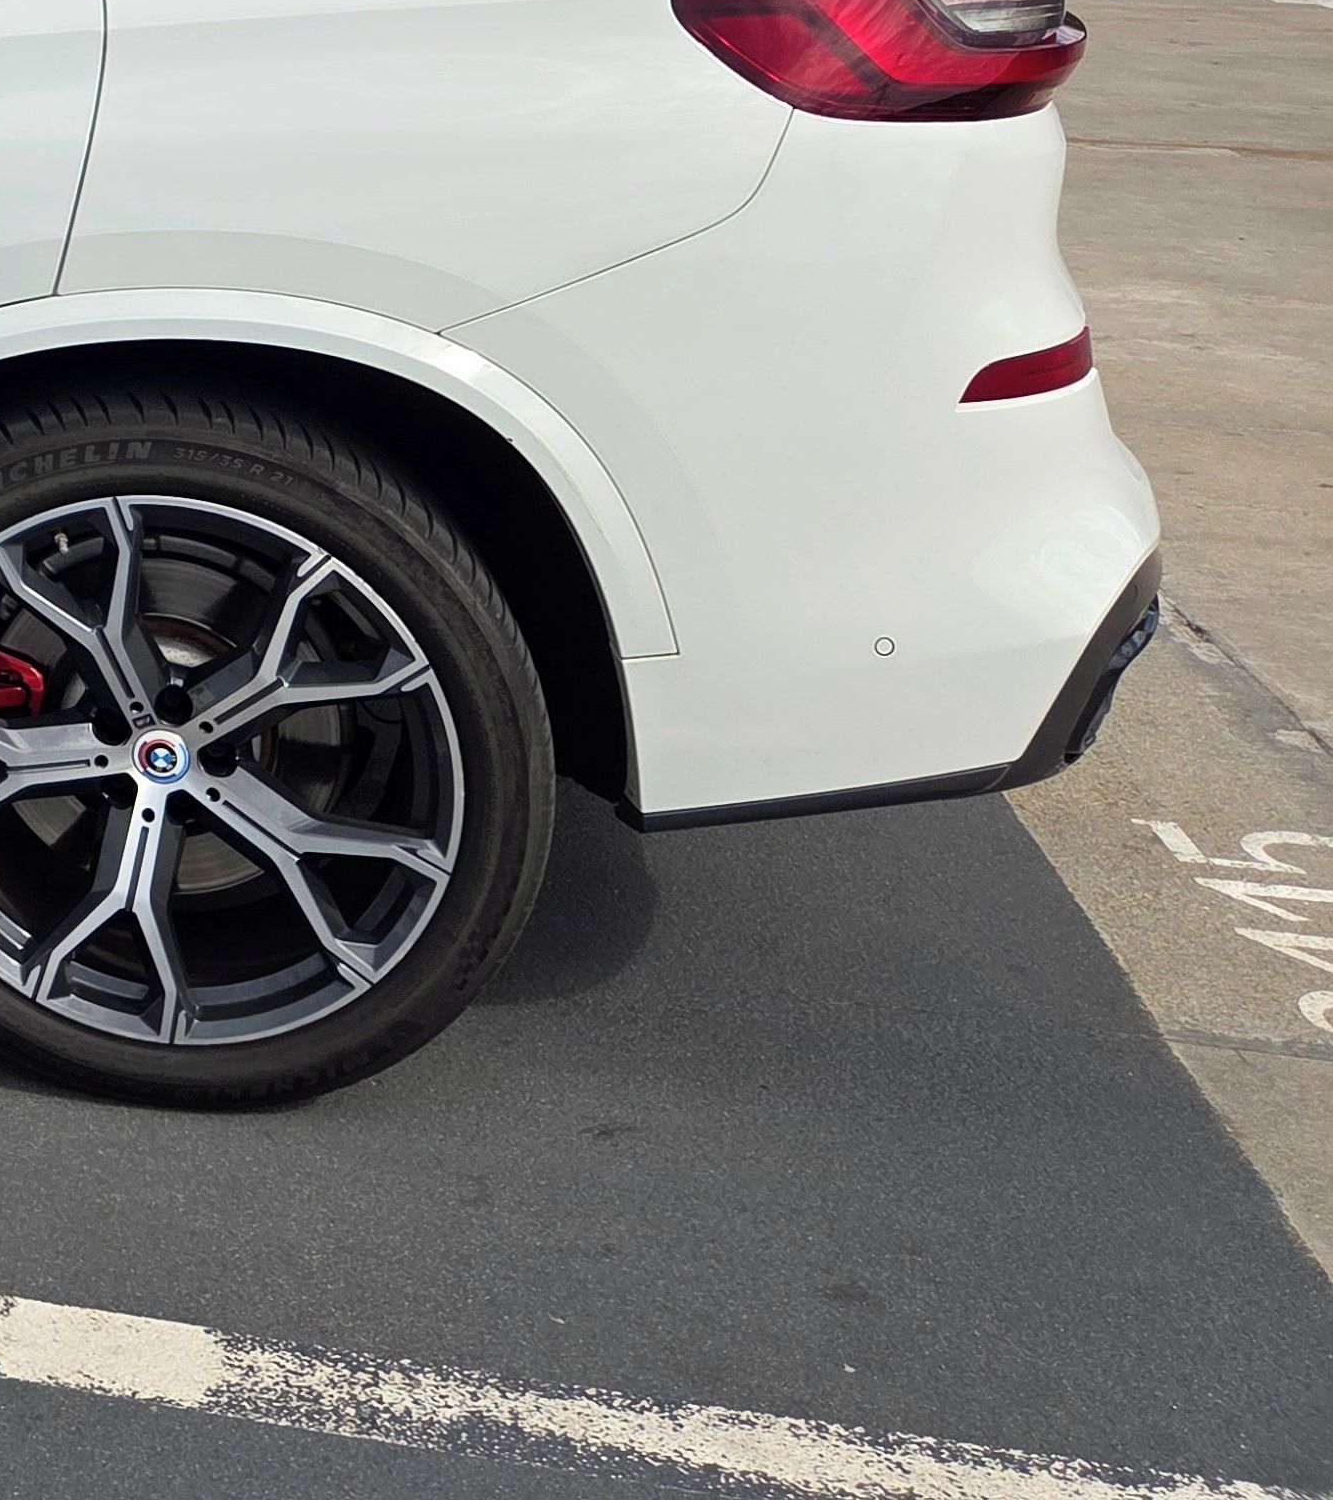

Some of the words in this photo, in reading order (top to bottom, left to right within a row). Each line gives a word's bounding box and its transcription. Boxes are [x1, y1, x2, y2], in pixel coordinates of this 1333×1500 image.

[171, 447, 242, 470] 315/35
[250, 461, 266, 478] R
[269, 470, 294, 486] 21
